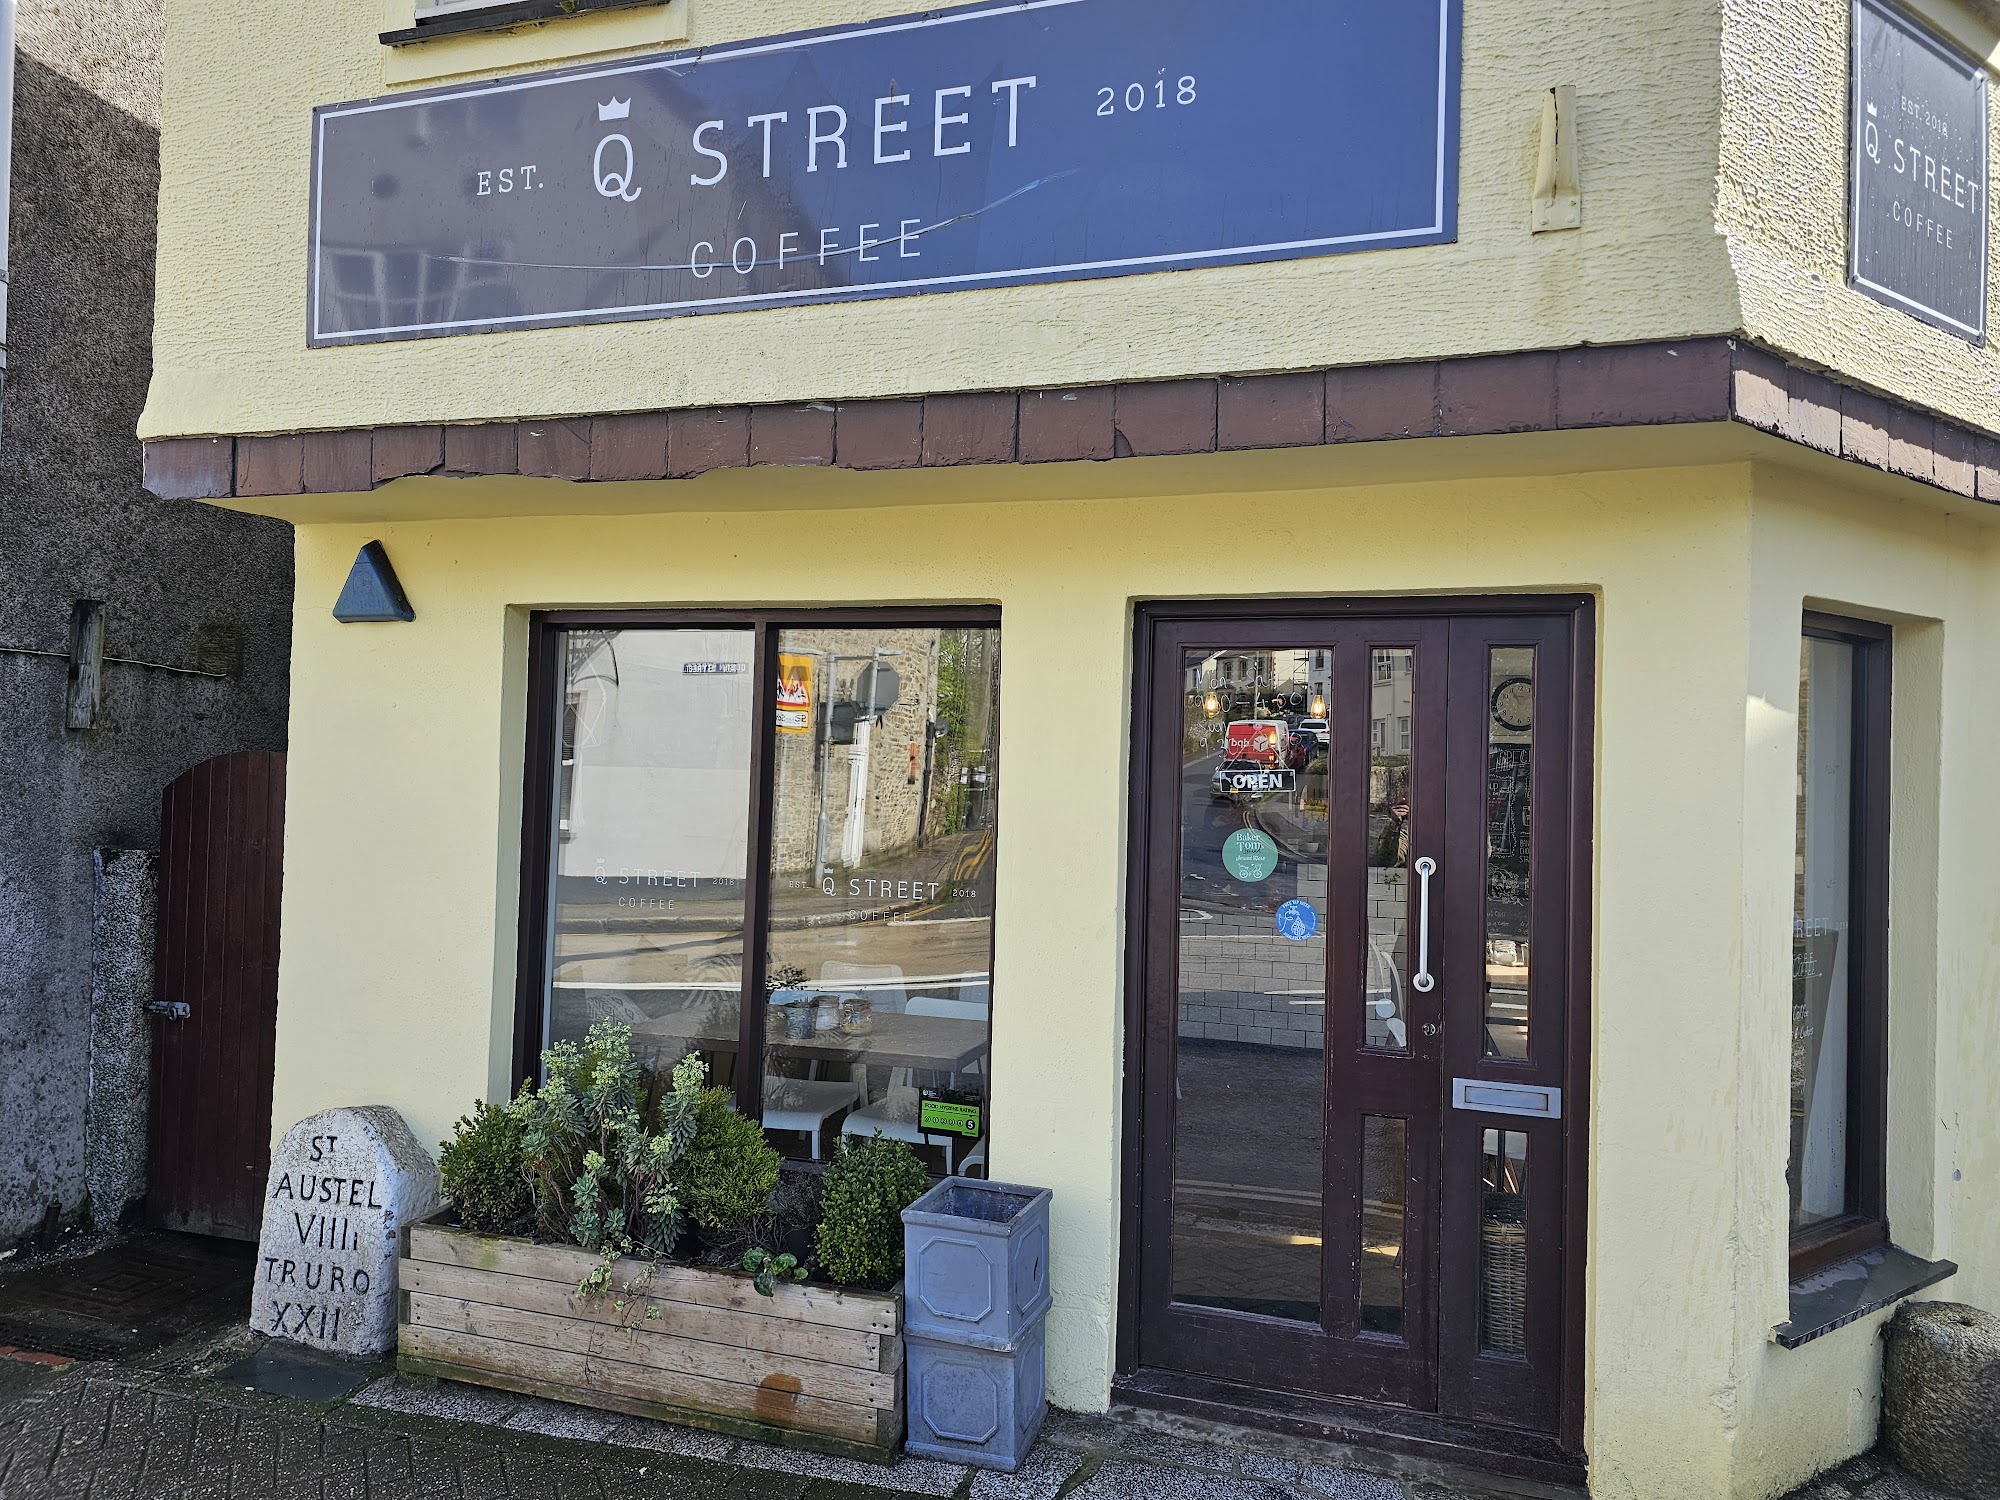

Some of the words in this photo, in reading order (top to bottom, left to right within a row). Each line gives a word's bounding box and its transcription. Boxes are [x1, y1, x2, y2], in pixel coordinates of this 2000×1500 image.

[1925, 112, 1948, 136] 2018
[477, 165, 544, 196] EST.
[594, 133, 642, 202] Q
[690, 75, 1037, 187] STREET
[1096, 75, 1198, 118] 2018
[1865, 119, 1881, 164] Q
[1894, 138, 1979, 214] STREET
[1893, 200, 1953, 250] COFFEE
[690, 218, 922, 280] COFFEE
[1232, 773, 1283, 789] OPEN
[1236, 832, 1261, 842] Baker
[594, 866, 607, 885] Q
[618, 867, 701, 888] STREET
[712, 877, 735, 887] 2018
[822, 876, 837, 897] Q
[849, 878, 939, 901] STREET
[952, 888, 977, 899] 2018
[618, 896, 675, 910] COFFEE
[849, 909, 910, 923] COFFEE
[309, 1135, 338, 1162] ST
[272, 1172, 382, 1210] AUSTEL
[265, 1257, 370, 1296] TRURO
[271, 1300, 341, 1342] XXII
